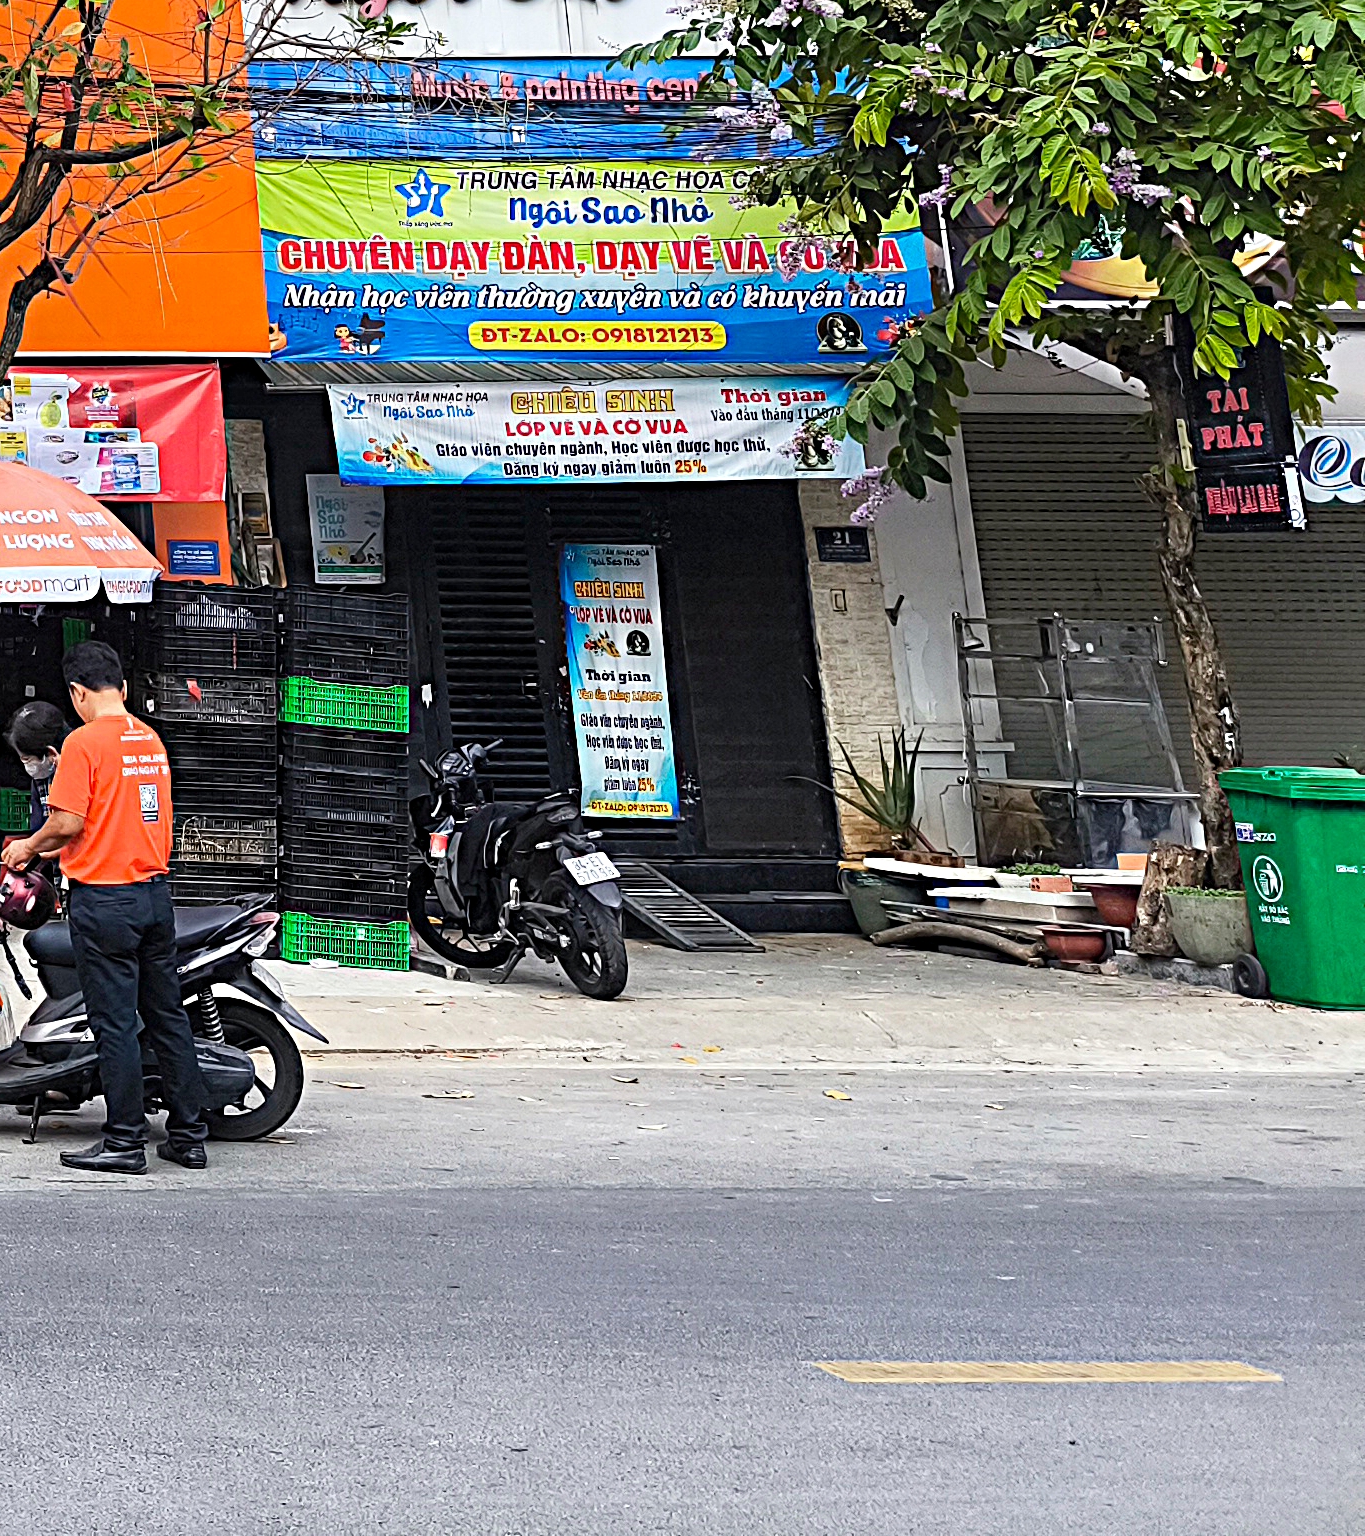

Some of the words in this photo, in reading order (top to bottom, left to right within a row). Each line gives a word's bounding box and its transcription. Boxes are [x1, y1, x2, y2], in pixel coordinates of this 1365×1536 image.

[456, 172, 537, 190] TRUNG
[548, 166, 595, 189] TÂM
[600, 171, 667, 193] NHẠC
[509, 197, 578, 228] Ngôi
[581, 196, 645, 224] Sao
[650, 196, 714, 225] Nhỏ
[279, 234, 416, 272] CHUYÊN
[423, 241, 491, 277] DẠY
[501, 235, 586, 275] ĐÀN,
[594, 241, 661, 277] DẠY
[672, 235, 712, 271] VẼ
[722, 233, 770, 272] VÀ
[284, 283, 355, 314] Nhận
[362, 285, 410, 315] học
[413, 287, 470, 308] viên
[476, 283, 574, 314] thường
[580, 285, 662, 314] xuyên
[667, 284, 703, 308] và
[707, 282, 736, 308] có
[742, 280, 841, 314] khuyến
[850, 283, 906, 307] mãi
[481, 327, 586, 343] ĐT-ZALO:
[592, 327, 714, 343] 0918121213
[366, 393, 404, 403] TRUNG
[406, 391, 429, 403] TÂM
[721, 388, 772, 404] Thời
[777, 391, 827, 407] gian
[1206, 381, 1251, 414] TÀI
[416, 405, 445, 419] Sao
[761, 407, 794, 423] tháng
[580, 417, 609, 436] VÀ
[645, 418, 689, 435] VUA
[1200, 415, 1265, 451] PHÁT
[675, 459, 707, 474] 25%
[0, 508, 59, 525] NGON
[317, 509, 345, 525] Sao
[4, 532, 75, 552] LƯỢNG
[832, 531, 851, 544] 21
[613, 581, 646, 599] SINH
[633, 608, 653, 625] VUA
[585, 668, 616, 682] Thời
[618, 670, 652, 685] gian
